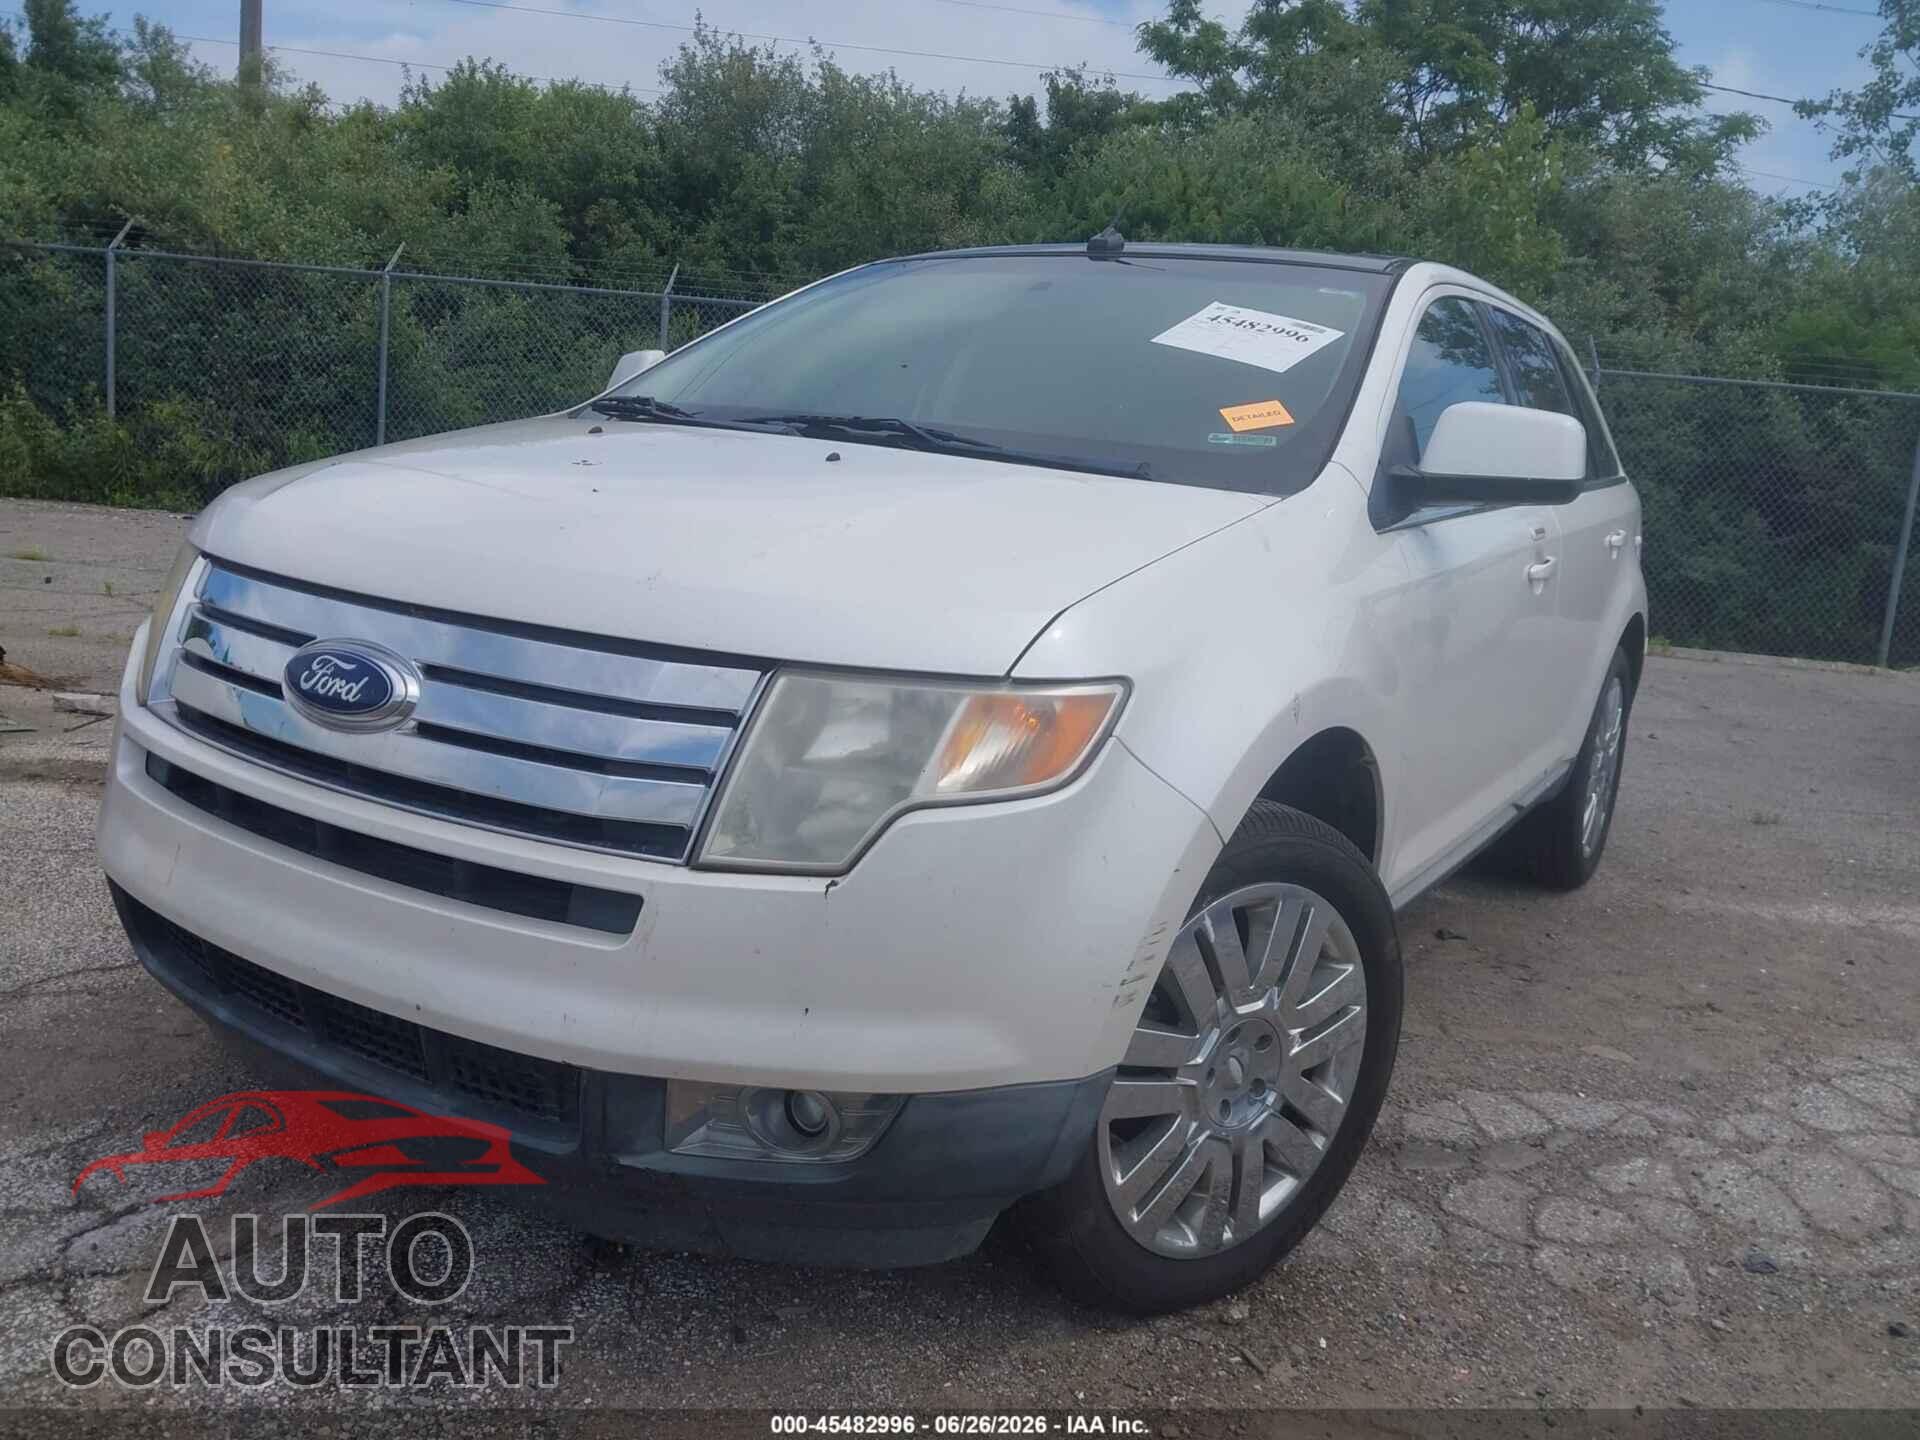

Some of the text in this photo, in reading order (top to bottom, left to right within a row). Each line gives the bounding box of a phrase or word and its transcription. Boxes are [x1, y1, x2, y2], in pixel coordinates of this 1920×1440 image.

[1205, 312, 1311, 344] 45482996
[1232, 409, 1281, 423] DETAILED
[300, 655, 369, 703] Ford
